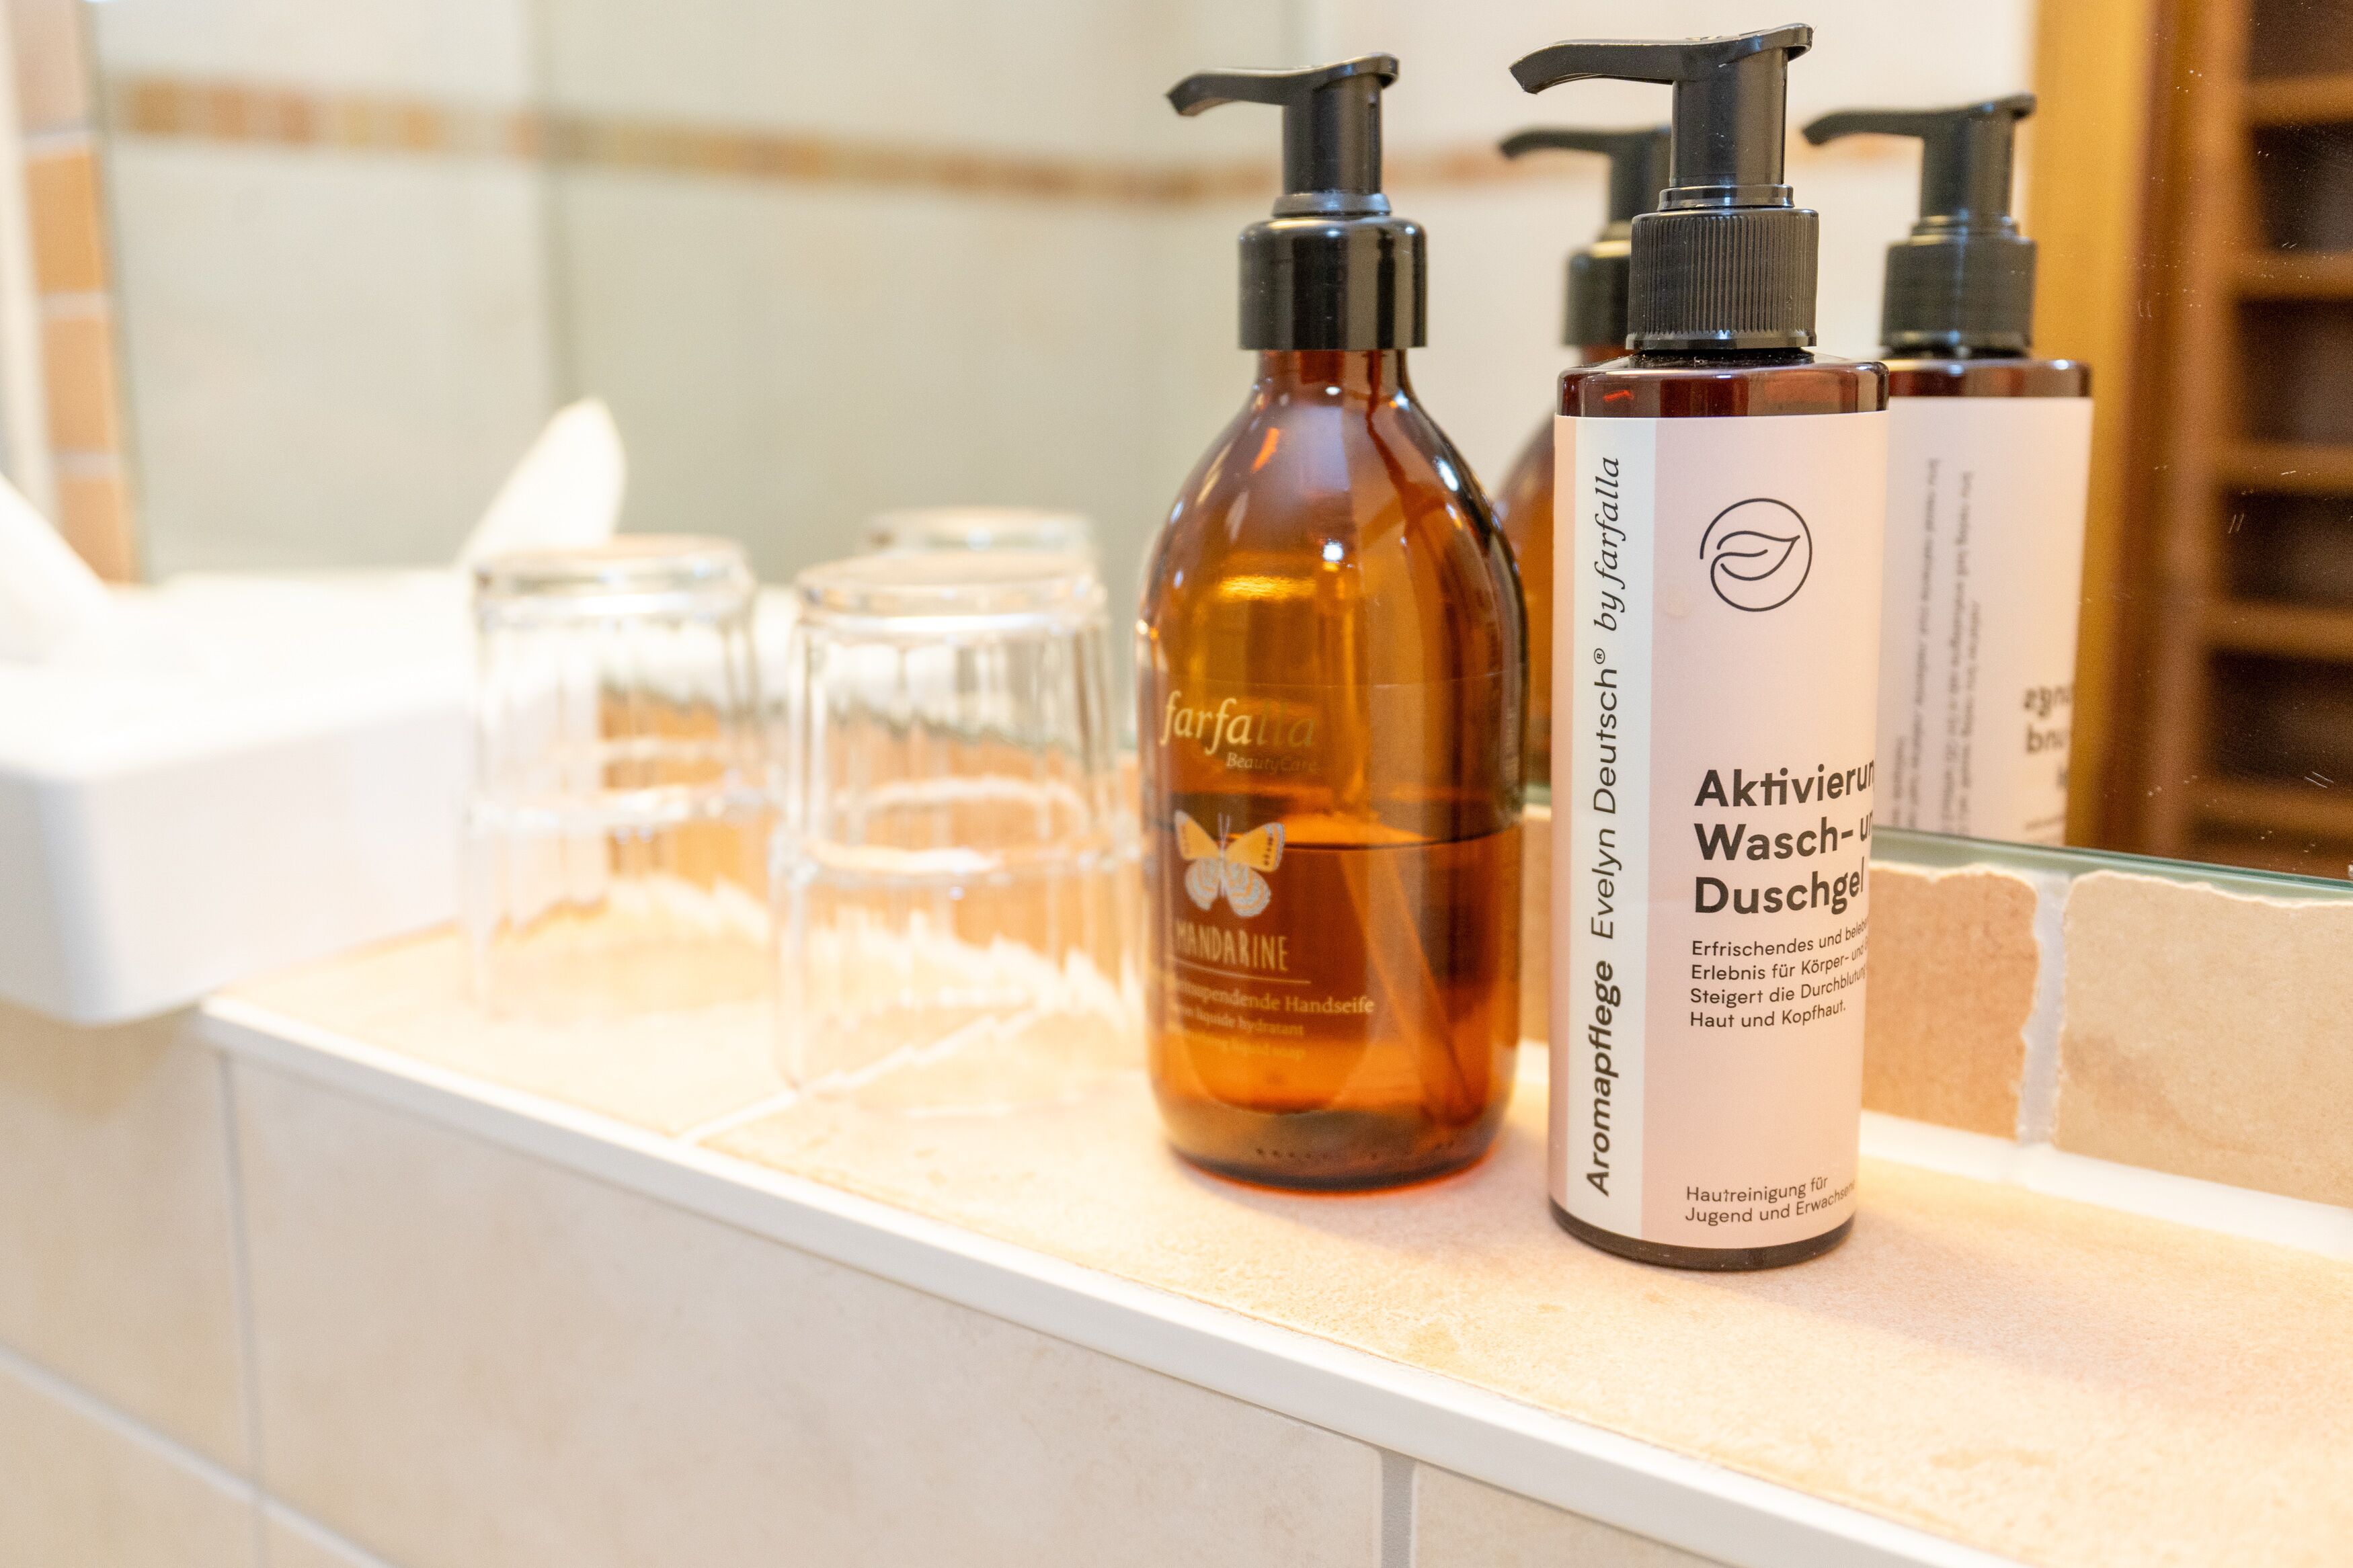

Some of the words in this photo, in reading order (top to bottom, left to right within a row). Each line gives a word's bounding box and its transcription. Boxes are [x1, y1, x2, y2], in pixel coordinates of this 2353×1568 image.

[1594, 457, 1626, 589] farfalla
[1593, 591, 1625, 632] by
[1159, 690, 1317, 756] farfalla
[1694, 759, 1874, 807] Aktivierun
[1693, 816, 1853, 861] Wasch-
[1591, 828, 1622, 939] Evelyn
[1695, 857, 1865, 915] Duschgel
[1692, 938, 1814, 957] Erfrischendes
[1819, 929, 1842, 949] und
[1691, 964, 1765, 981] Erlebnis
[1771, 962, 1795, 979] für
[1801, 955, 1849, 975] Körper-
[1285, 995, 1375, 1014] Handseife
[1690, 988, 1763, 1009] Steigert
[1769, 987, 1795, 1003] die
[1690, 1012, 1734, 1028] Haut
[1741, 1011, 1775, 1028] und
[1782, 998, 1846, 1026] Kopfhaut.
[1587, 960, 1621, 1197] Aromapflege
[1686, 1182, 1806, 1203] Hautreinigung
[1810, 1176, 1829, 1192] für
[1685, 1207, 1753, 1227] Jugend
[1759, 1204, 1790, 1222] und
